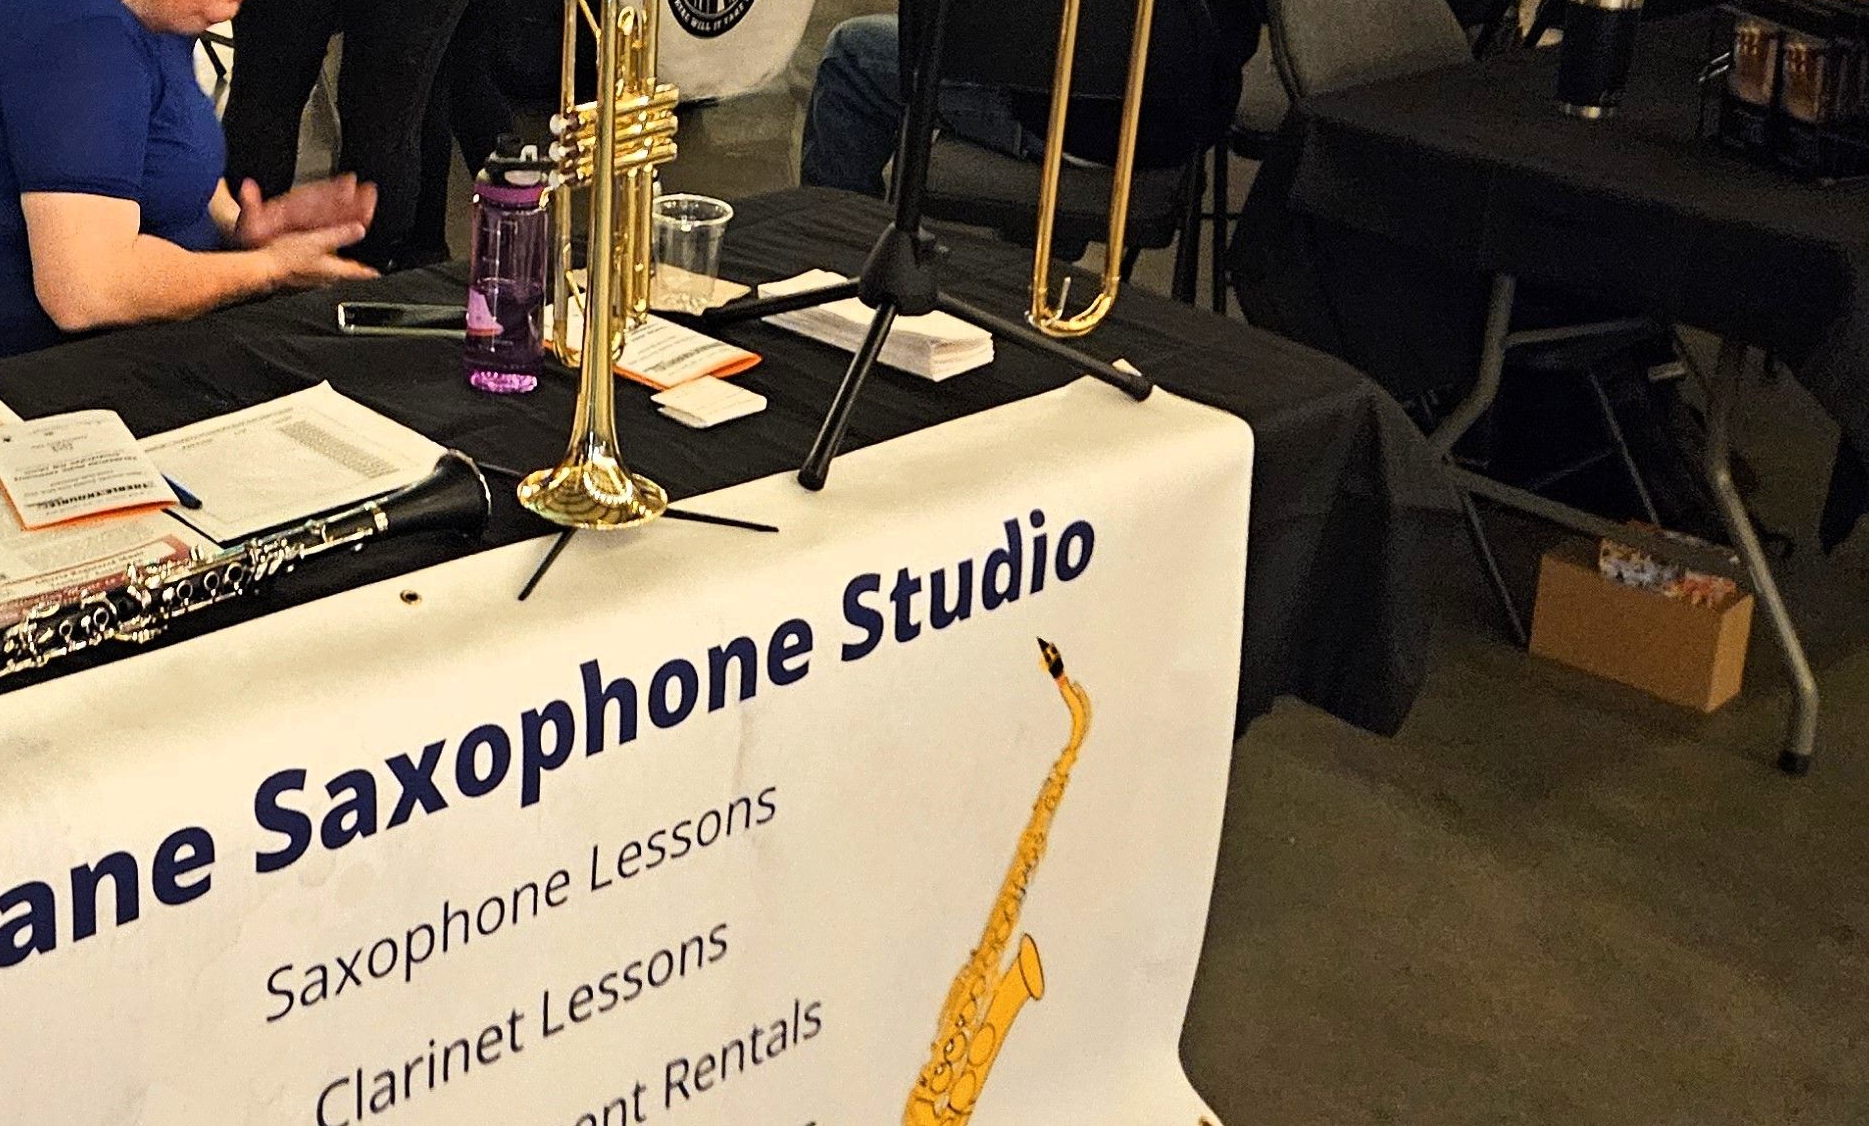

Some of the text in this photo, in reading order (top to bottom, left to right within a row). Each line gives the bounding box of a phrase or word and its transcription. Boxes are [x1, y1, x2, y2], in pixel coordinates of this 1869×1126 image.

[690, 18, 712, 32] WILL
[255, 617, 813, 873] Saxophone
[842, 508, 1095, 662] Studio
[265, 786, 777, 1022] Saxophone Lessons
[316, 923, 729, 1126] Clarinet Lessons
[663, 997, 823, 1111] Rentals
